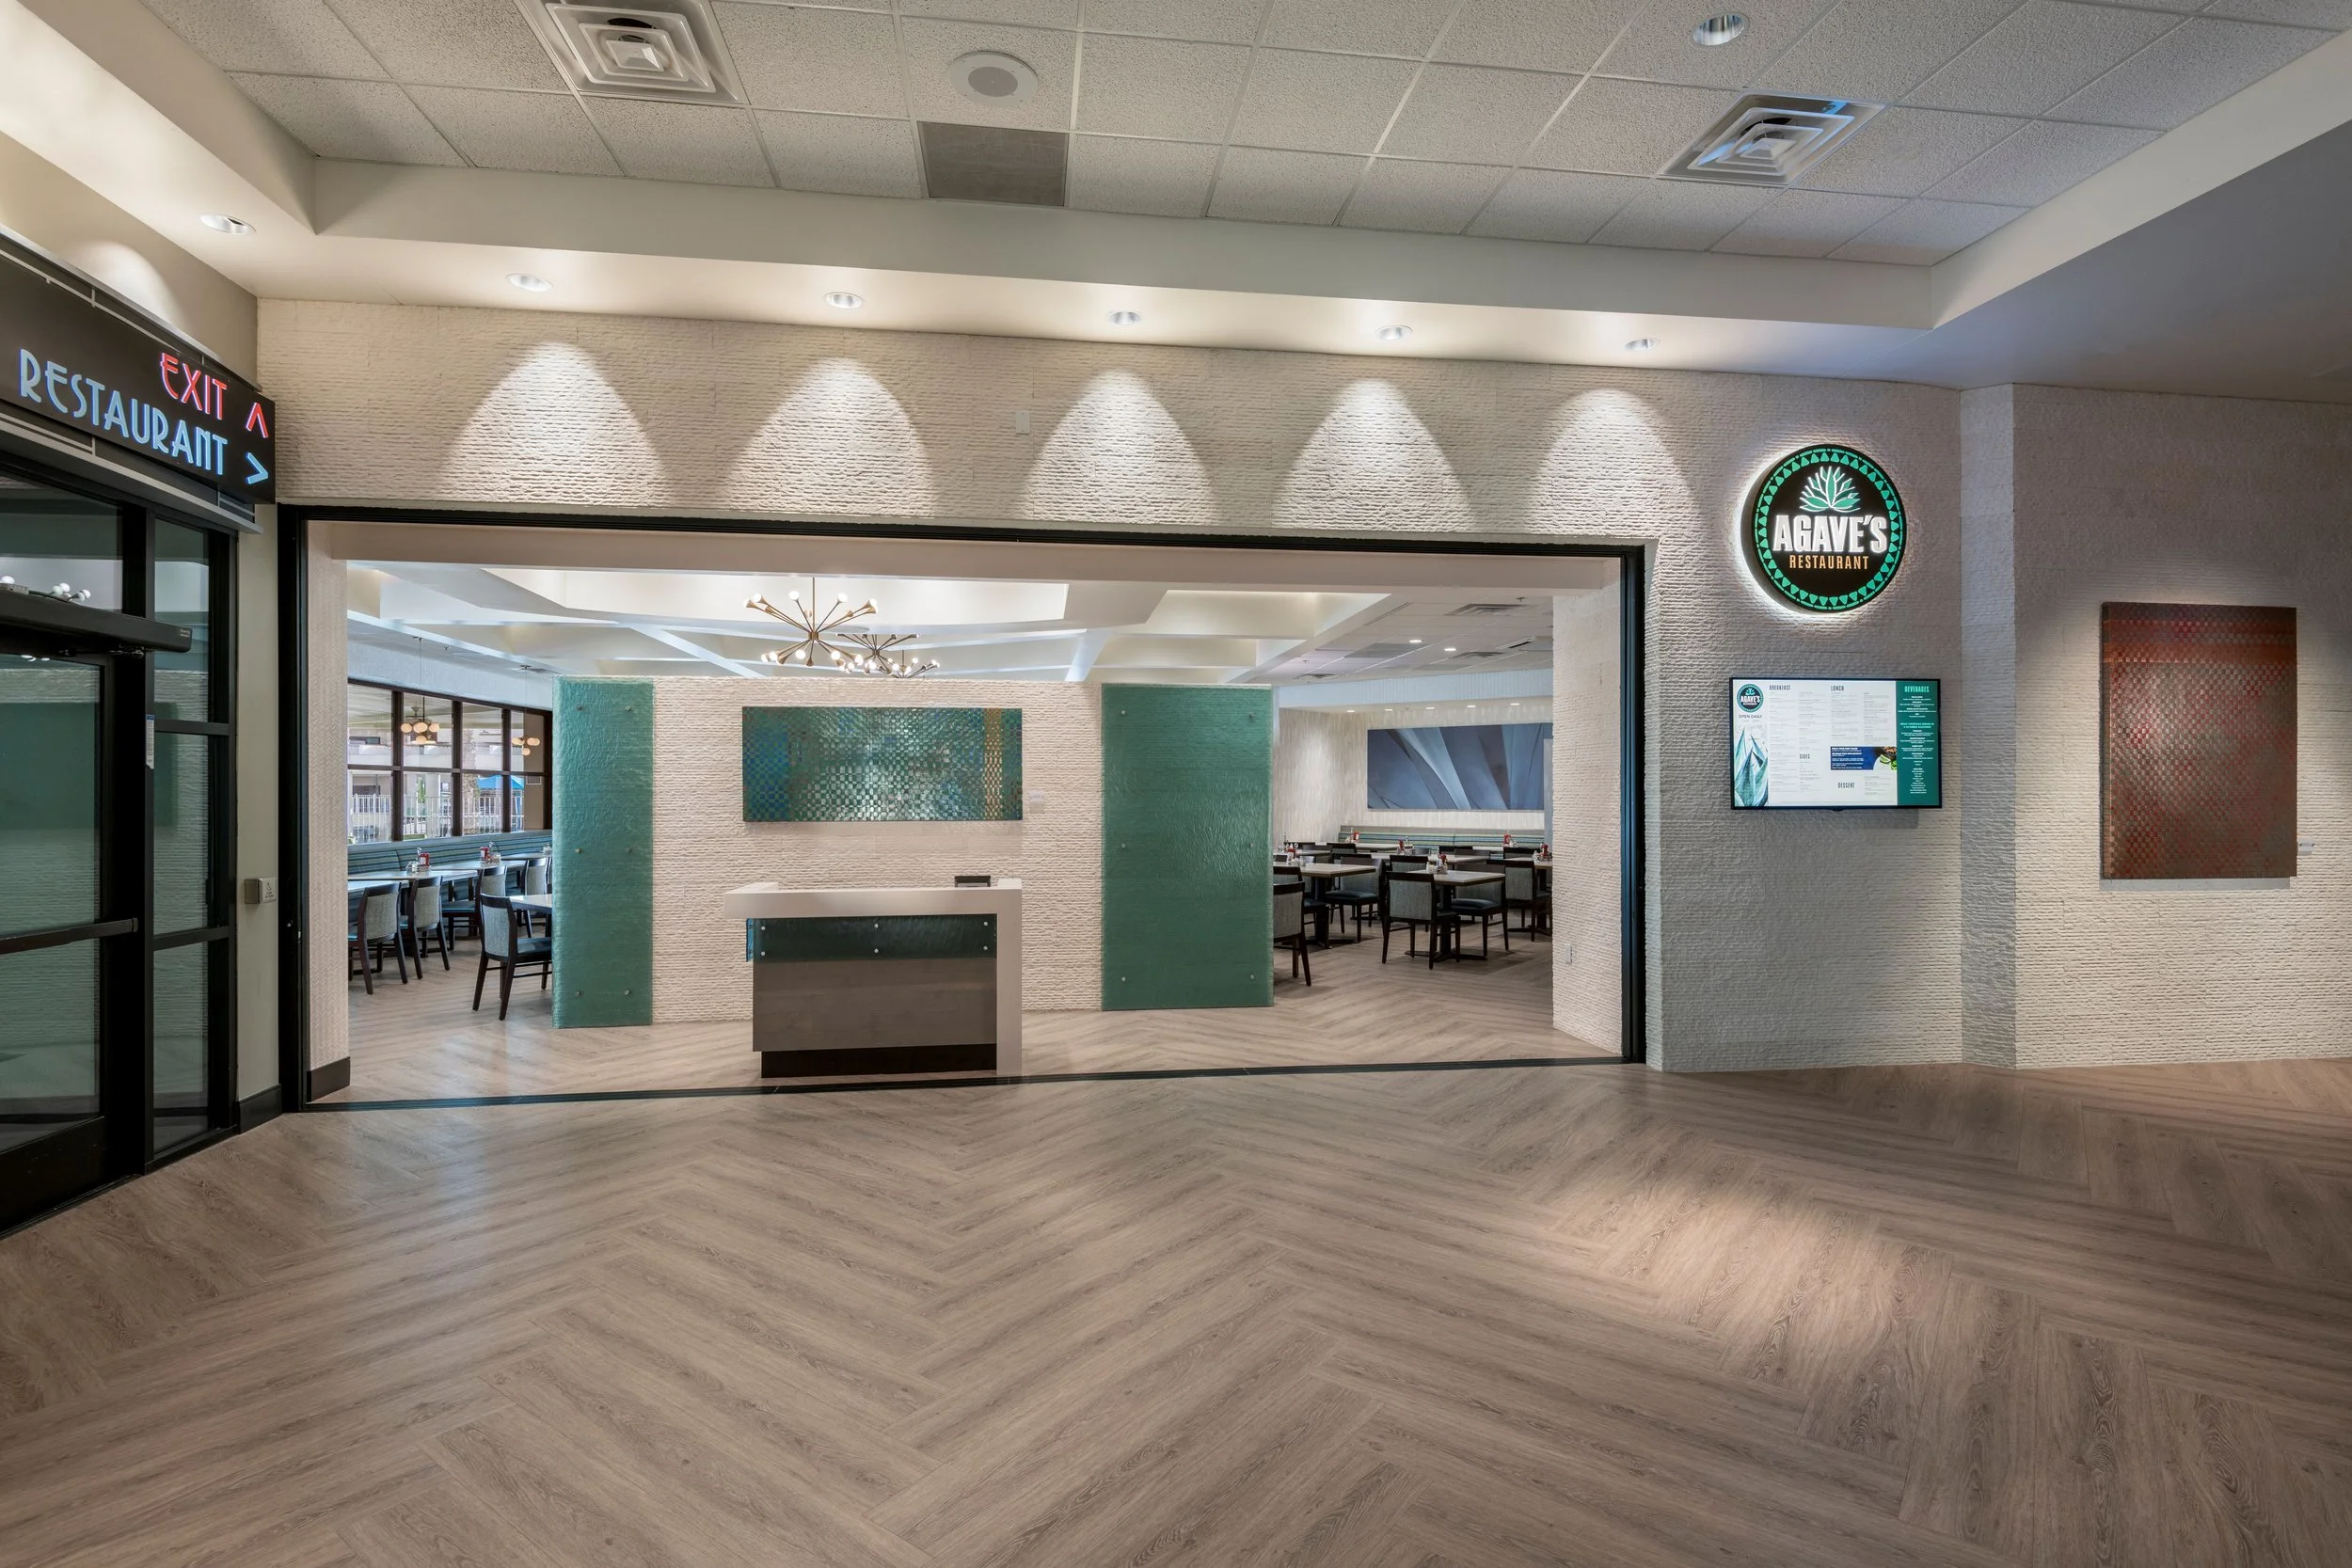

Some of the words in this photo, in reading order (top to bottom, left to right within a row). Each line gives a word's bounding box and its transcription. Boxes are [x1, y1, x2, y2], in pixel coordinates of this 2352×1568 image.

[19, 348, 229, 476] RESTAURANT
[160, 352, 228, 420] EXIT
[1772, 514, 1888, 554] AGAVE'S
[1789, 555, 1869, 570] RESTAURANT
